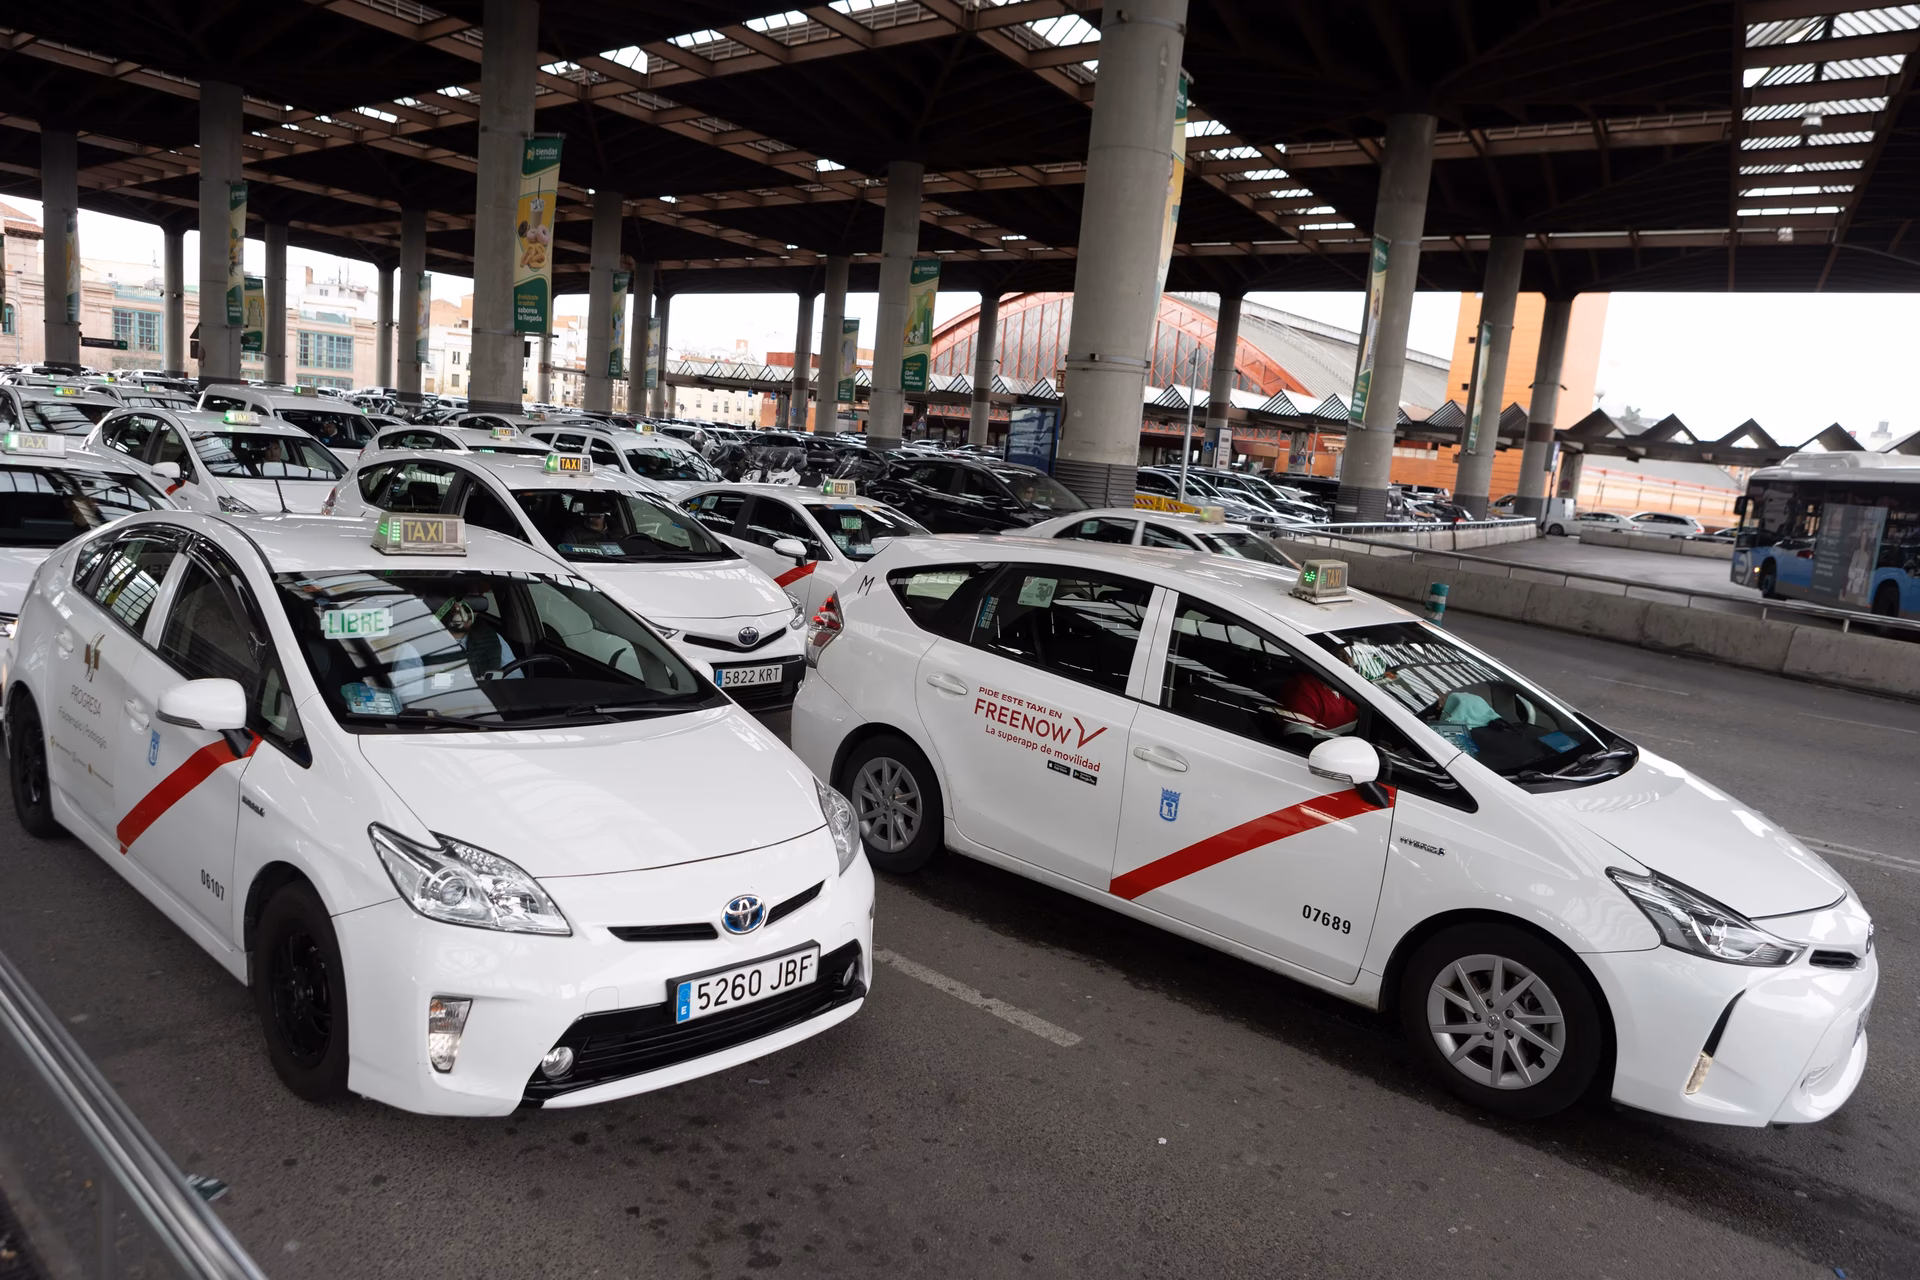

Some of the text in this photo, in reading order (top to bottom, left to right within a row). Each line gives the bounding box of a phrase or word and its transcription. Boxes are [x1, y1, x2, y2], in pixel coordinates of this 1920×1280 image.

[536, 148, 558, 156] tiendas
[20, 434, 48, 450] TAXI
[560, 458, 580, 470] TAXI
[404, 521, 442, 542] TAXI
[857, 574, 875, 596] M
[1327, 569, 1342, 587] TAXI
[328, 610, 384, 634] LIBRE
[724, 668, 780, 684] 5822 KRT
[70, 684, 102, 718] PROGRESA
[978, 686, 1063, 719] PIDE ESTE TAXI EN
[974, 698, 1072, 744] FREENOW
[986, 724, 1101, 772] La superapp de movilidad
[201, 868, 224, 901] 06107
[1302, 904, 1351, 934] 07689
[697, 954, 812, 1010] 5260 JBF
[681, 1005, 688, 1015] E
